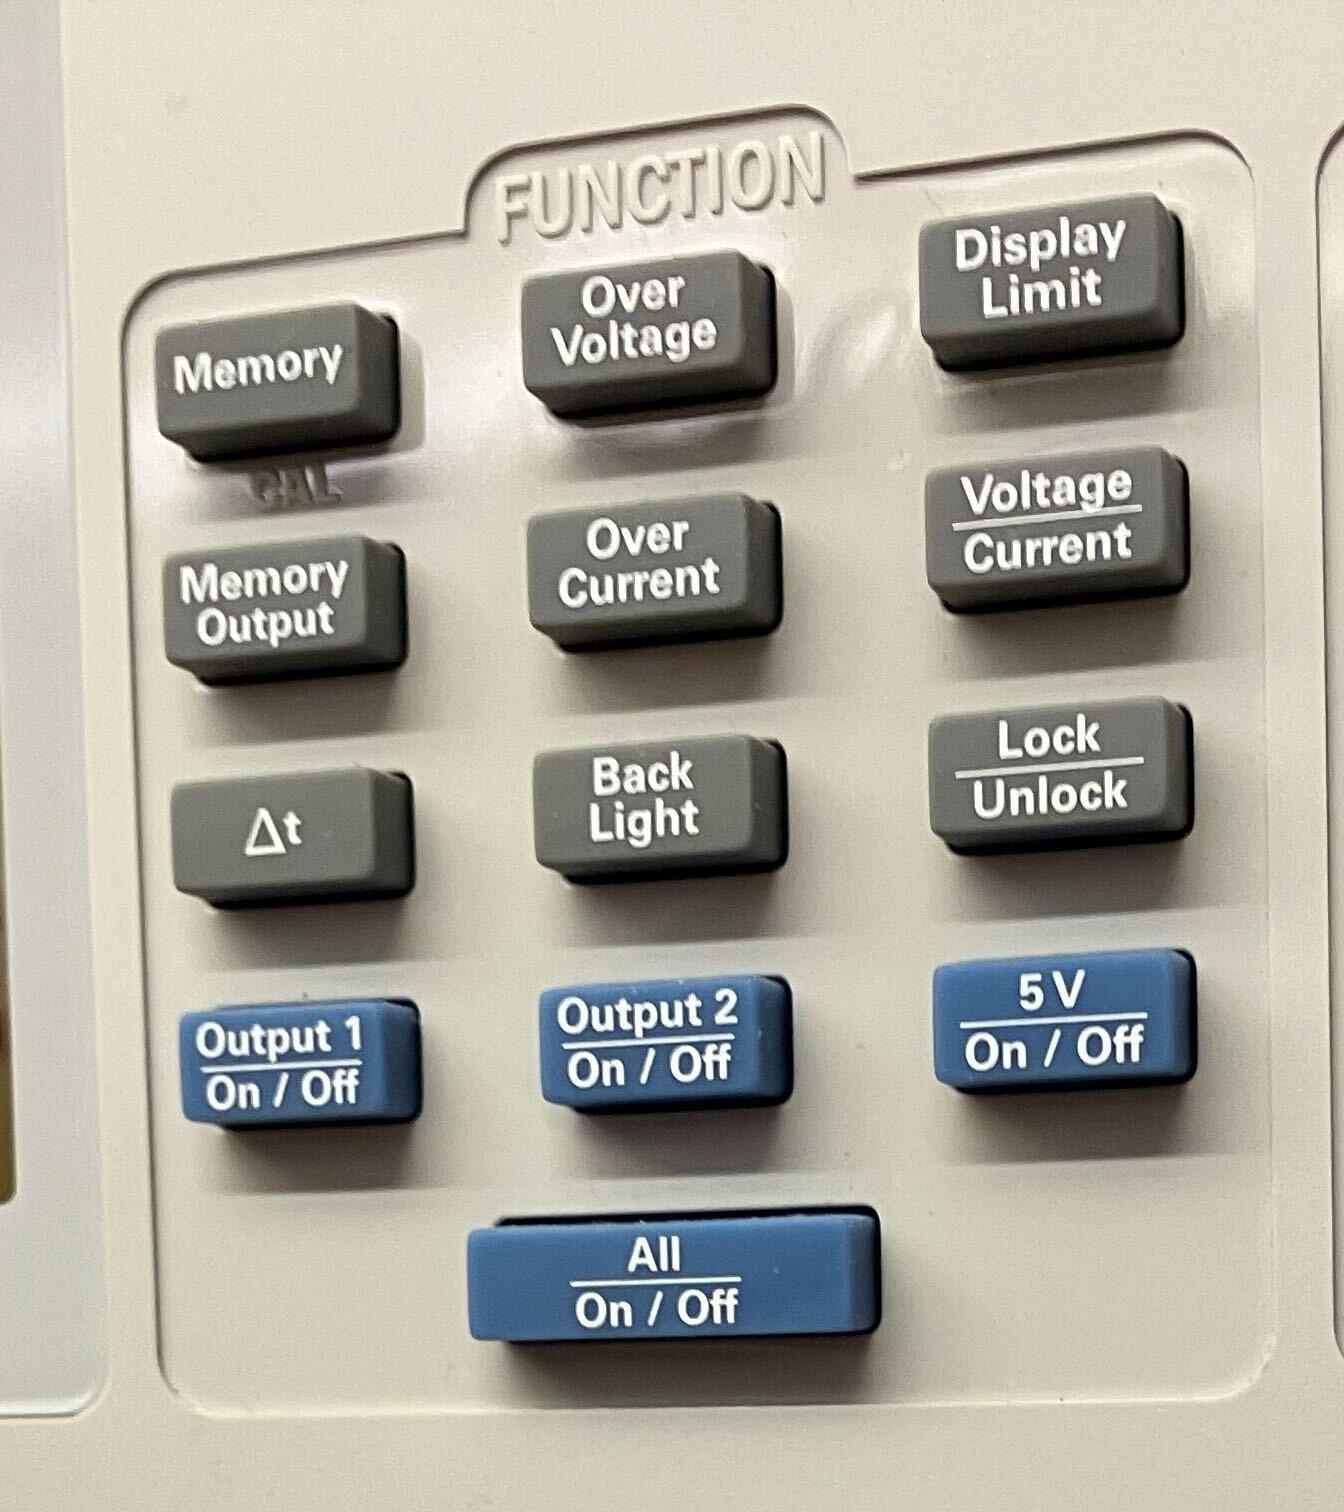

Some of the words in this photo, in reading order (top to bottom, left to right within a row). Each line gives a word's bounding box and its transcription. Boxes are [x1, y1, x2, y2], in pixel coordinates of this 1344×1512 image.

[495, 130, 827, 244] FUNCTION
[954, 216, 1126, 273] Display
[580, 272, 687, 317] Over
[981, 269, 1103, 320] Limit
[549, 316, 718, 366] Voltage
[174, 344, 344, 395] Memory
[247, 462, 342, 510] CAL
[959, 468, 1133, 516] Voltage
[586, 517, 690, 560] Over
[963, 521, 1133, 574] Current
[180, 559, 350, 604] Memory
[558, 556, 721, 608] Current
[194, 600, 335, 648] Output
[998, 713, 1102, 760] Lock
[593, 750, 695, 796] Back
[972, 769, 1129, 820] Unlock
[590, 797, 701, 848] Light
[196, 1020, 331, 1057] Output
[345, 1015, 362, 1051] 1
[557, 993, 702, 1038] Output
[714, 988, 740, 1026] 2
[567, 1053, 626, 1089] On
[668, 1044, 733, 1084] Off
[965, 1032, 1028, 1072] On
[1077, 1023, 1146, 1067] Off
[206, 1072, 261, 1111] On
[301, 1066, 360, 1107] Off
[627, 1234, 681, 1273] All
[575, 1291, 634, 1329] On
[677, 1287, 740, 1327] Off
